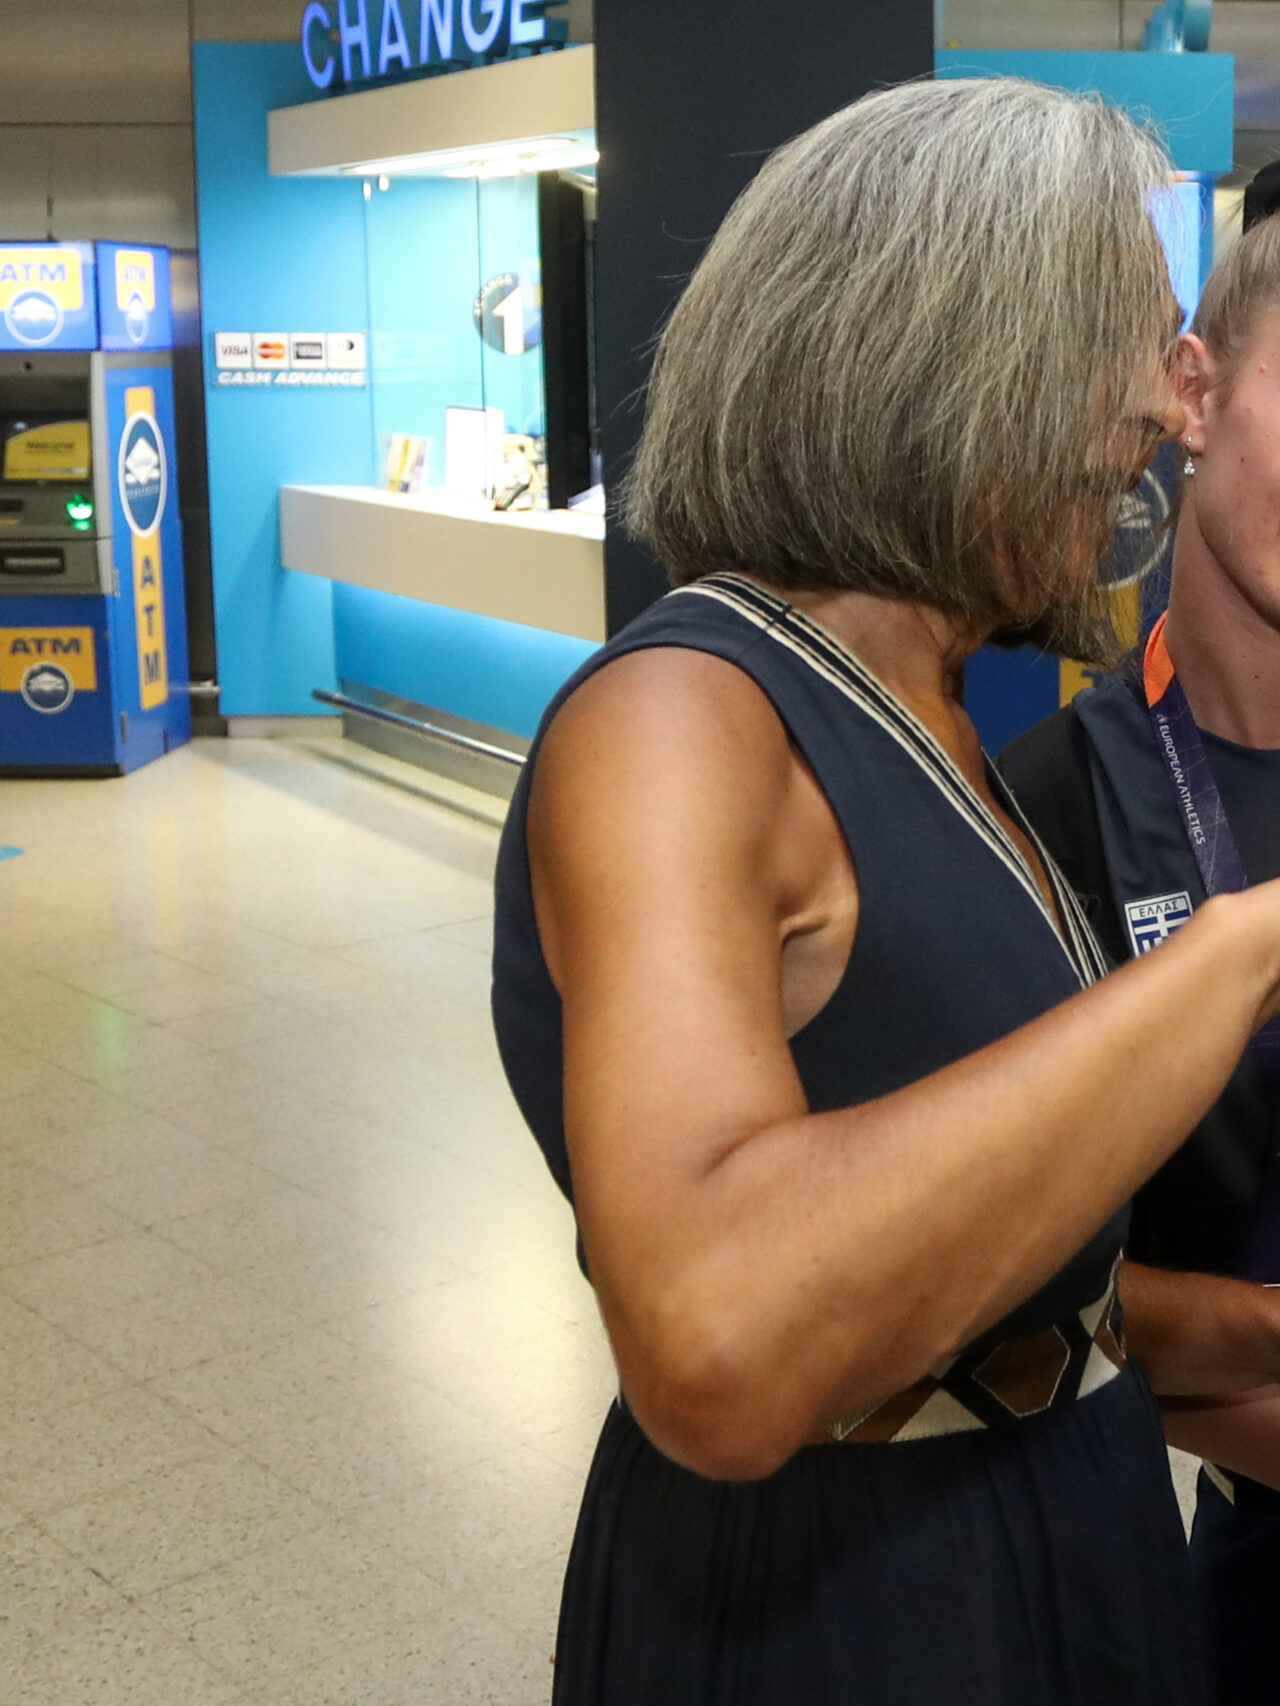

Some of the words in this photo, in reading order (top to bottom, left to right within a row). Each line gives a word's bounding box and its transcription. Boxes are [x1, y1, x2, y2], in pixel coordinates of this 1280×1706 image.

[302, 0, 546, 89] CHANGE
[0, 262, 67, 283] ATM
[218, 371, 272, 384] CASH
[274, 371, 364, 385] ADVANCE
[10, 638, 81, 654] ATM
[1159, 724, 1185, 784] EUROPEAN
[1178, 785, 1206, 845] ATHLETICS
[1138, 900, 1179, 918] ΕΛΛΑΣ
